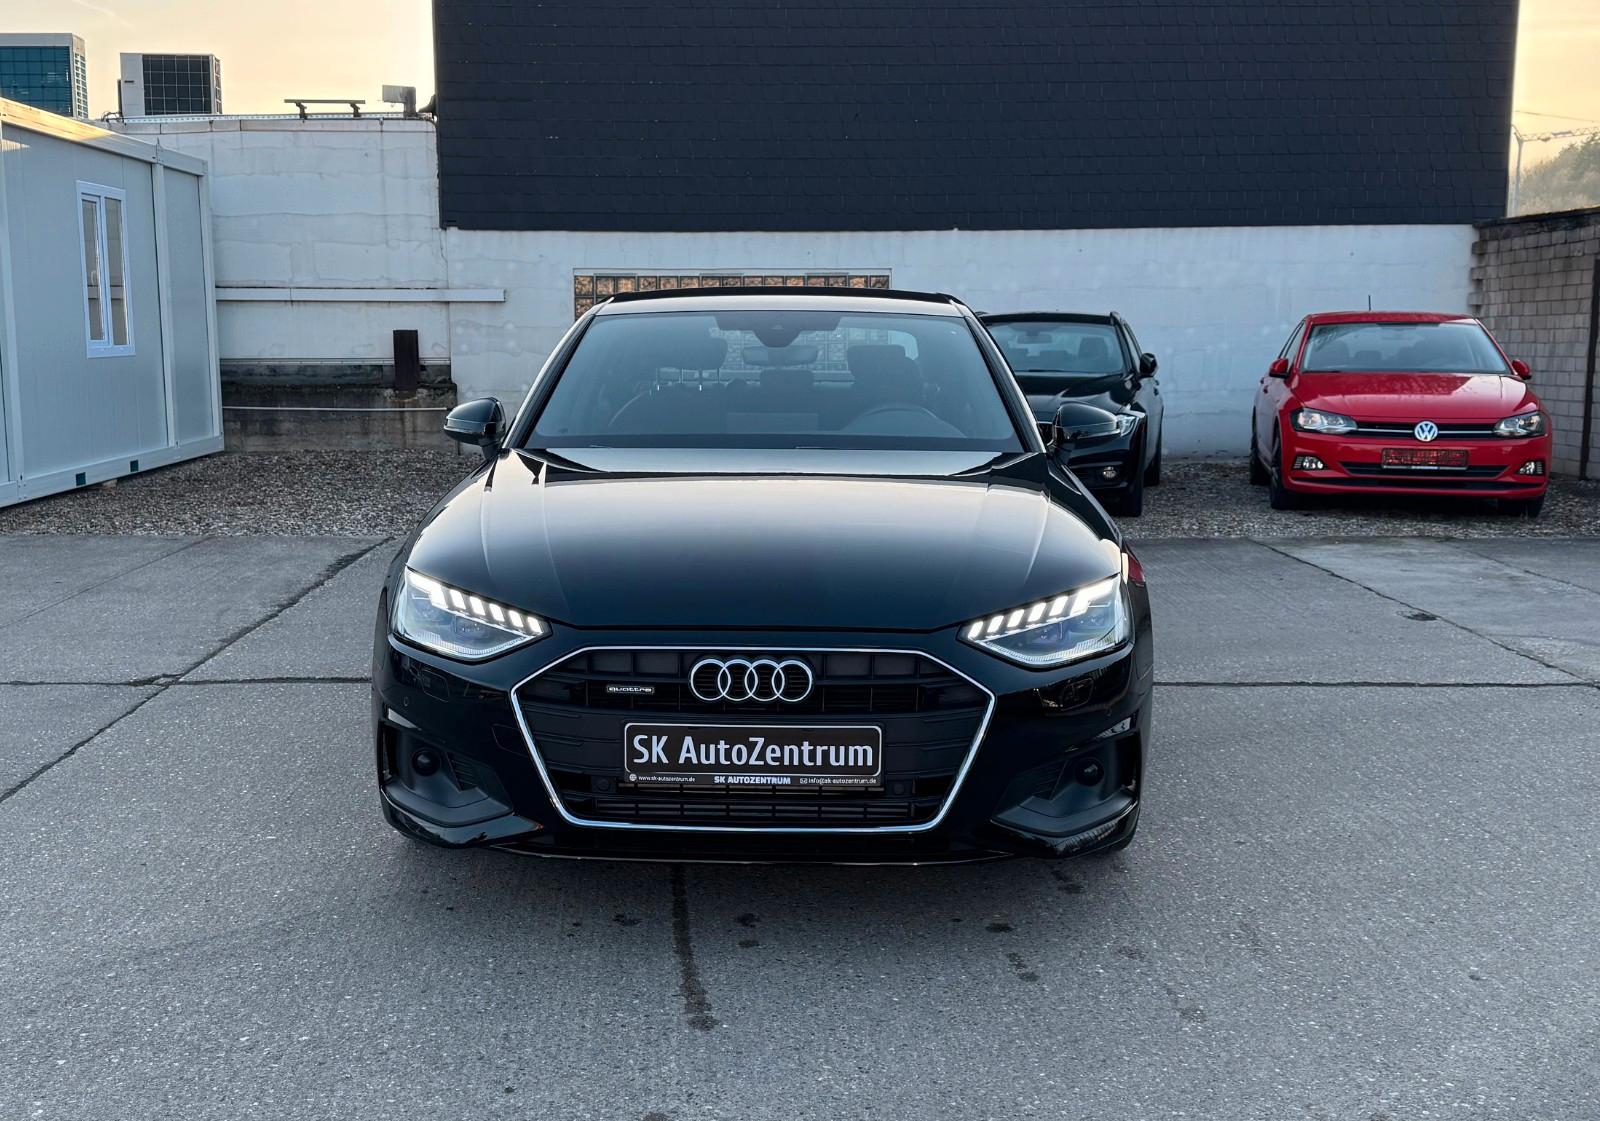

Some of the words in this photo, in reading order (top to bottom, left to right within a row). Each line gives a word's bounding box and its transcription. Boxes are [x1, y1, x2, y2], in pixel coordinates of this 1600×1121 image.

[633, 735, 668, 764] SK
[679, 736, 873, 766] AutoZentrum
[727, 776, 791, 784] AUTOZENTRUM
